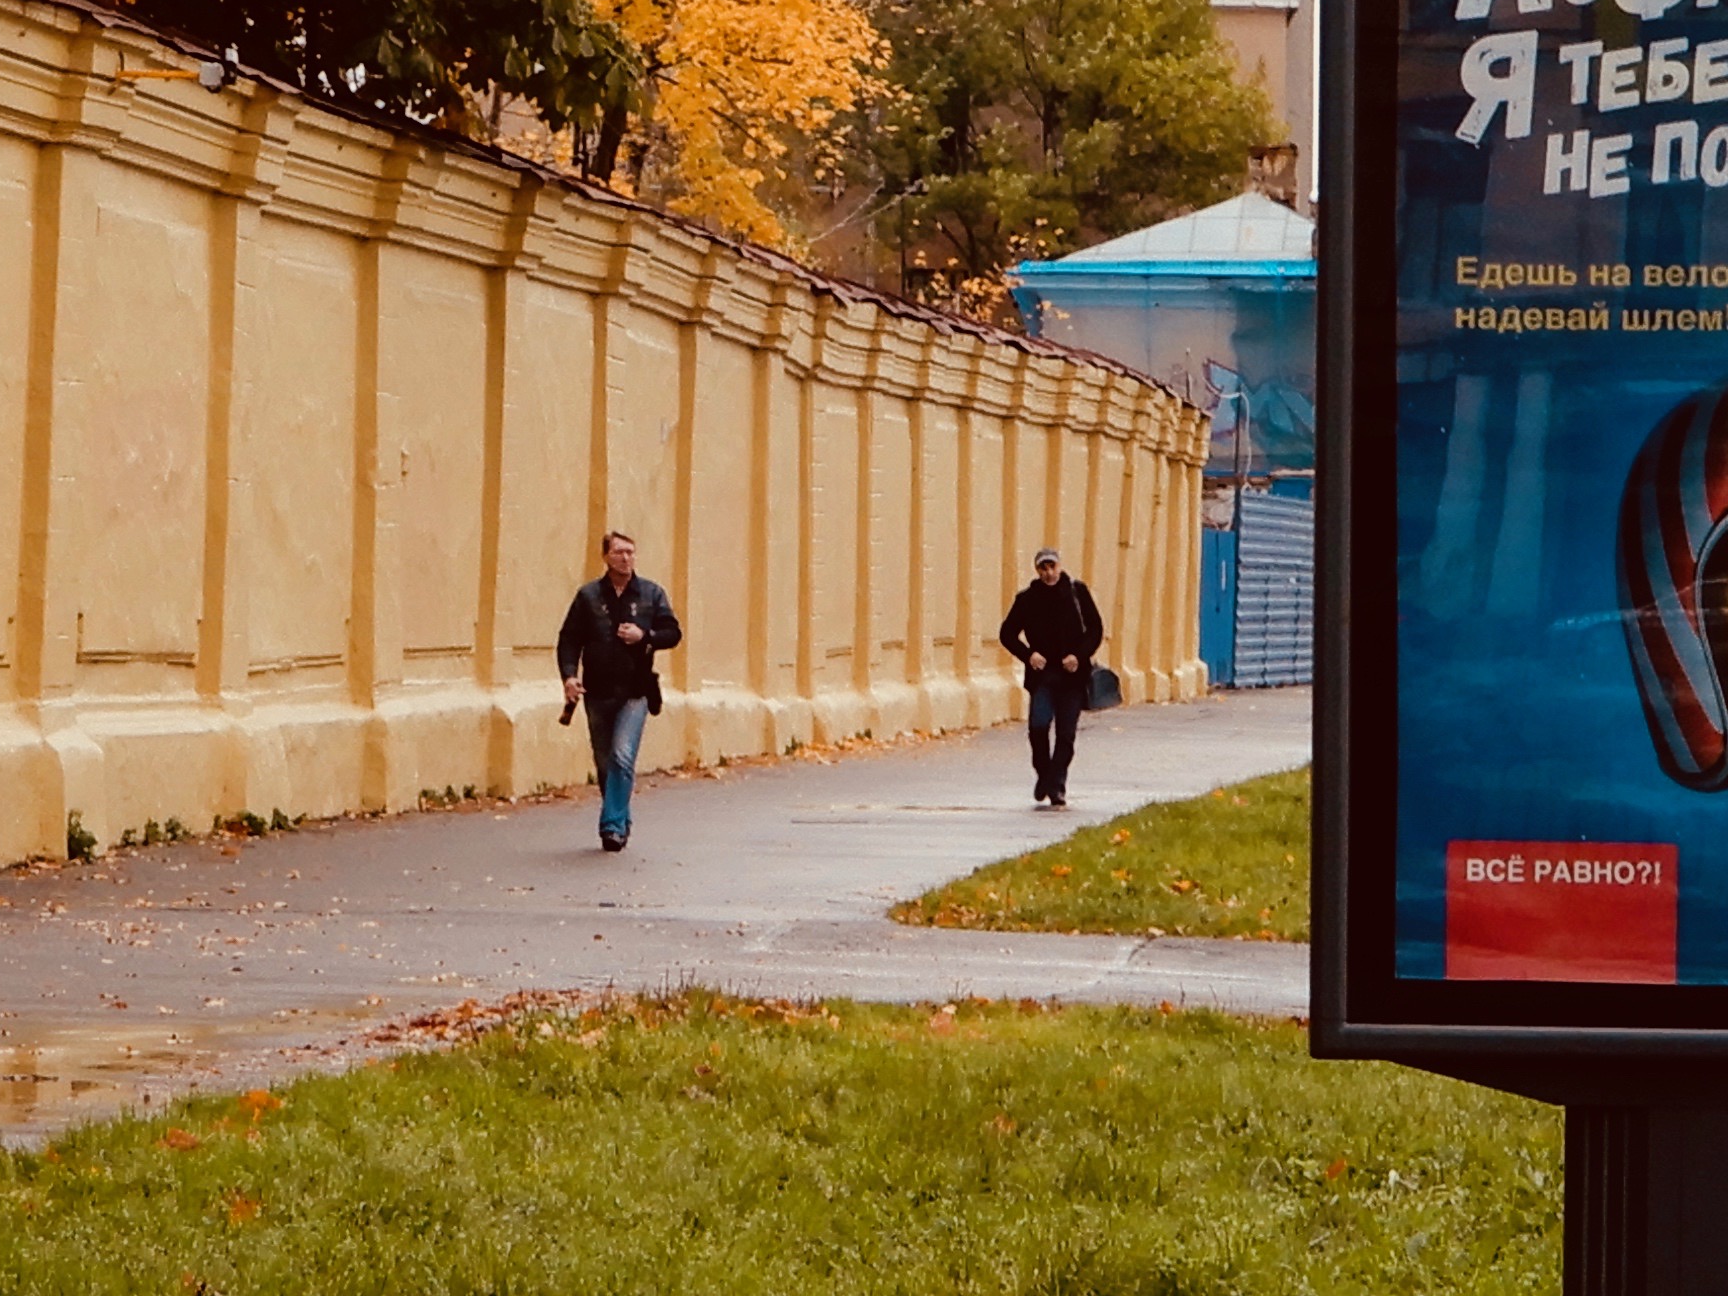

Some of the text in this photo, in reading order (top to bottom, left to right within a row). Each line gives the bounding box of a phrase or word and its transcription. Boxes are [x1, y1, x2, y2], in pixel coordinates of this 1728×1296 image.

[1455, 29, 1539, 144] Я
[1543, 129, 1633, 198] НЕ
[1455, 256, 1578, 289] Едешь
[1589, 263, 1631, 286] на
[1455, 301, 1610, 333] надевай
[1466, 854, 1662, 885] ВСЁ РАВНО?!
